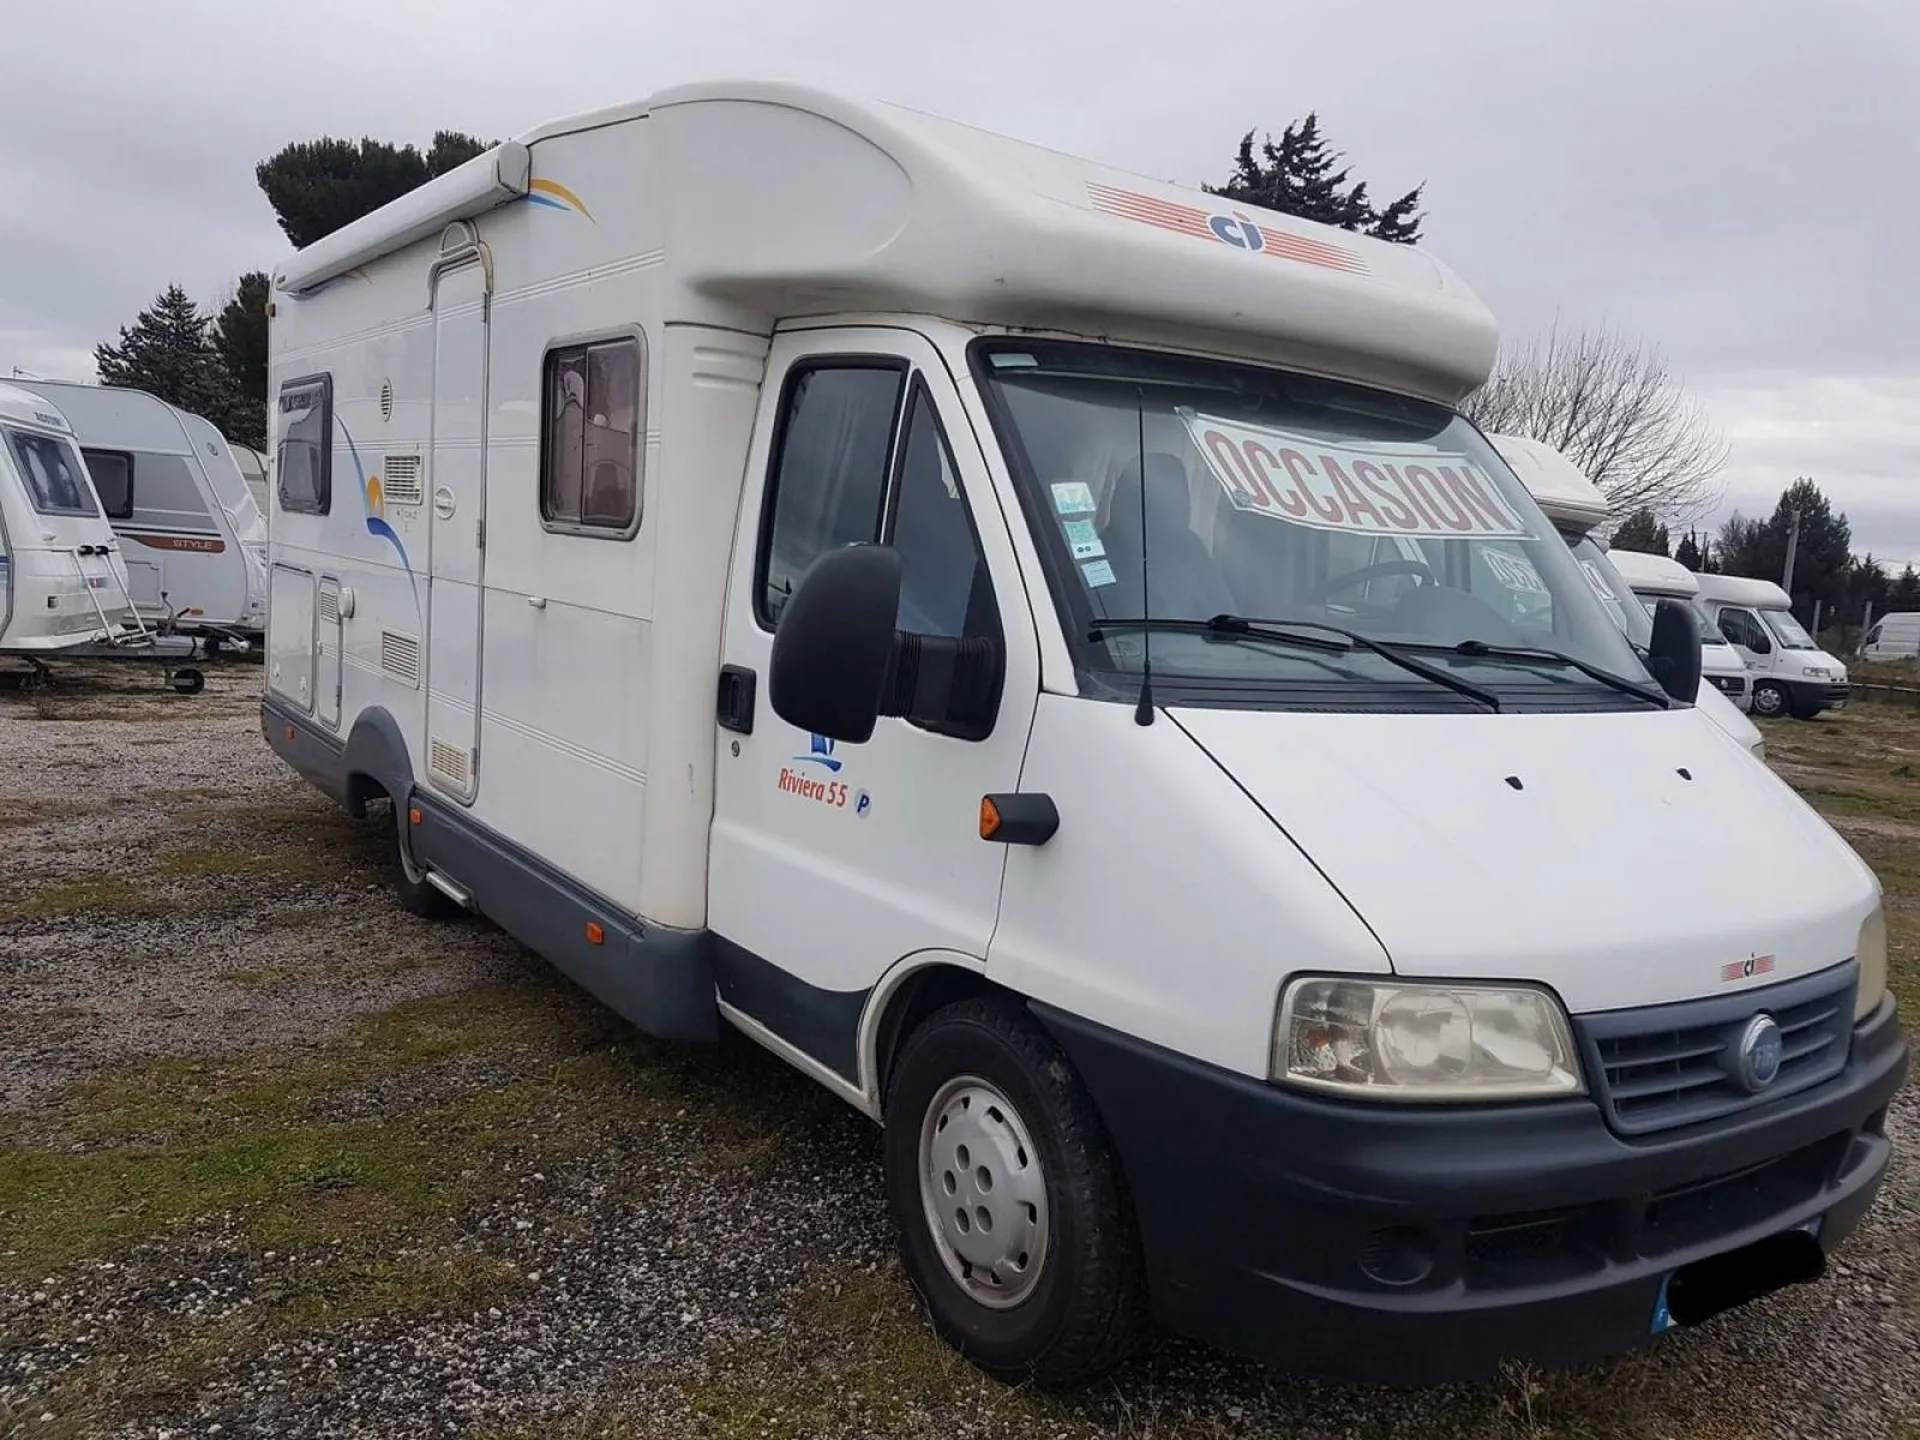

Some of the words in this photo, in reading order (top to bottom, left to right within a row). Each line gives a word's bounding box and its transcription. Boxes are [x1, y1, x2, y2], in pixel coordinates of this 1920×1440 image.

[1204, 430, 1517, 531] OCCASION
[173, 539, 213, 549] STYLE
[778, 767, 825, 802] Riviera
[826, 781, 848, 808] 55
